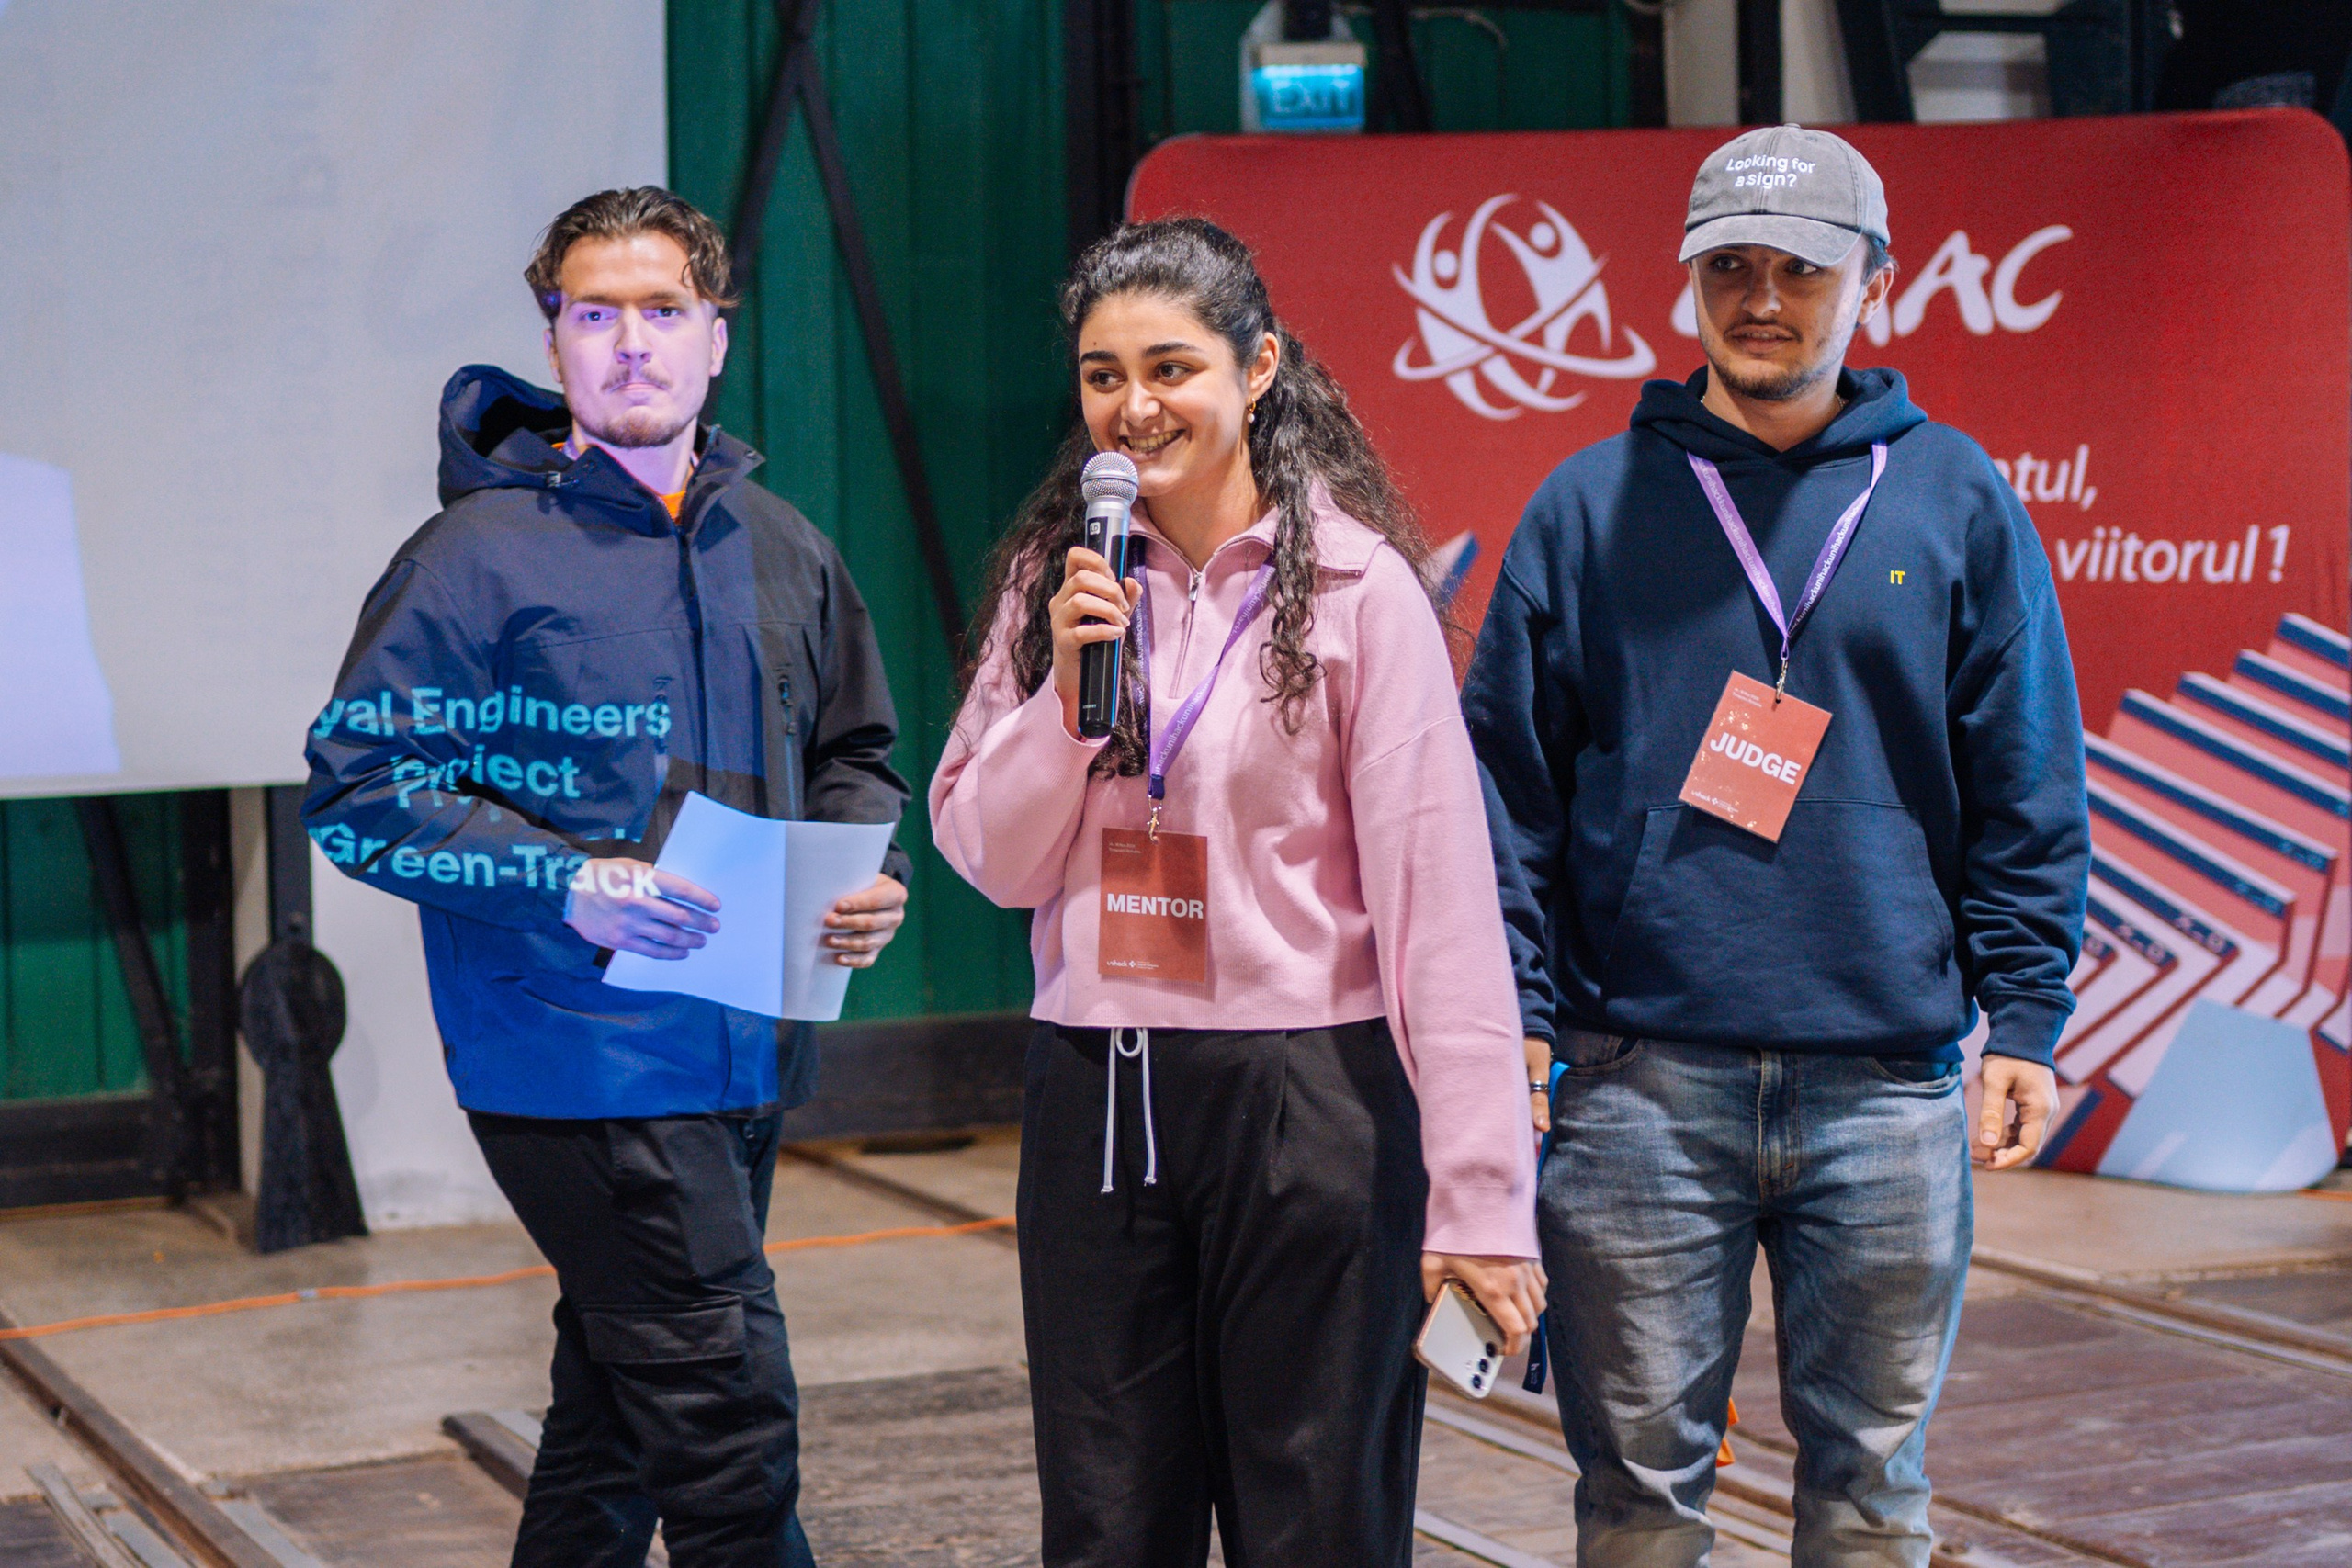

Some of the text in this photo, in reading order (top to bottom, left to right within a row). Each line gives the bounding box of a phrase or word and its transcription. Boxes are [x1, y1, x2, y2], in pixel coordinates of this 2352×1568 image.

[1726, 154, 1816, 174] Looking for
[1735, 171, 1798, 189] a sign?
[1890, 570, 1906, 585] IT
[313, 685, 672, 739] yal Engineers
[1710, 732, 1802, 784] JUDGE
[308, 823, 662, 899] Green-Track
[1107, 893, 1204, 919] MENTOR
